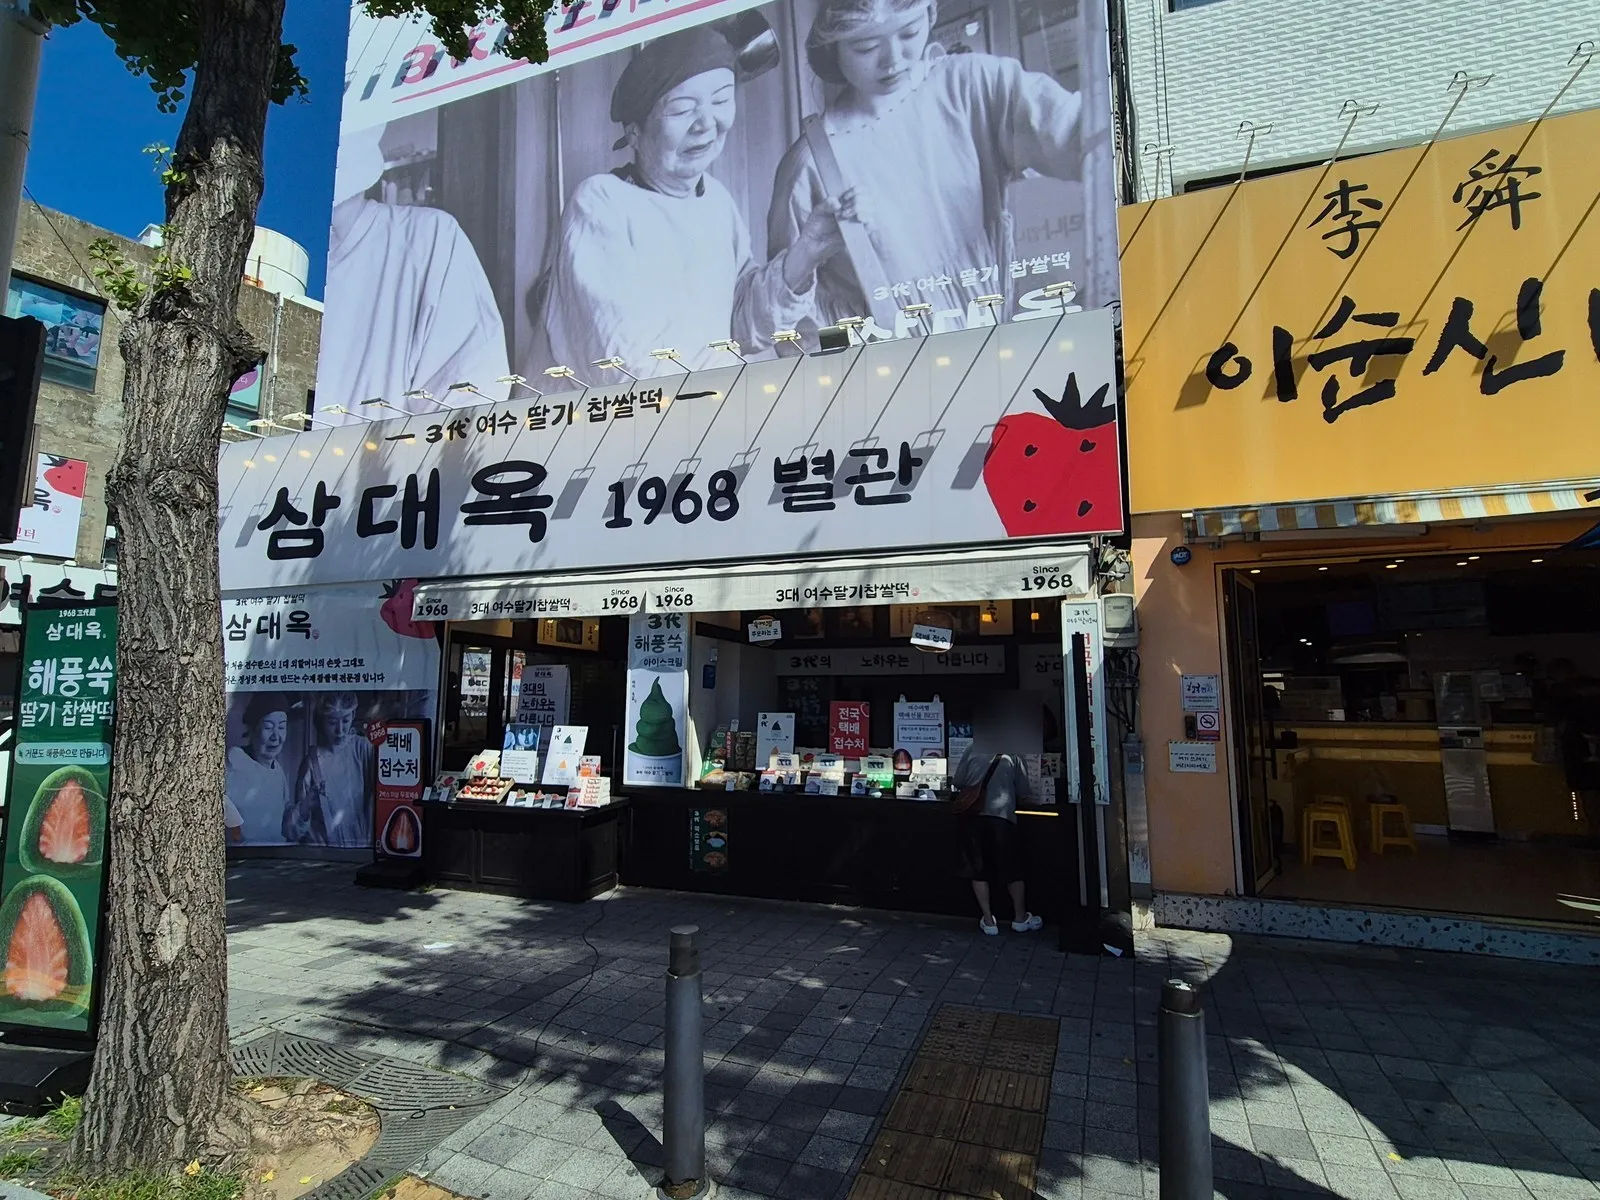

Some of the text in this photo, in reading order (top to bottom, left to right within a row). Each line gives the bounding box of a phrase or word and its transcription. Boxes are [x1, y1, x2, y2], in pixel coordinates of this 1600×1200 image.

[917, 273, 952, 292] 여수
[960, 264, 999, 287] 딸기
[1010, 251, 1071, 279] 찹쌀떡
[1206, 277, 1600, 424] 이순신
[476, 411, 517, 436] 여수
[528, 400, 573, 431] 딸기
[586, 387, 662, 422] 찹쌀떡
[257, 441, 923, 560] 삼대옥 1968 별관
[1033, 566, 1060, 574] Since
[1021, 574, 1073, 591] 1968
[655, 593, 694, 608] 1968
[776, 583, 910, 602] 3대 여수딸기찹쌀떡
[417, 604, 449, 616] 1968
[471, 598, 571, 615] 3대 여수딸기찹쌀떡
[602, 597, 638, 610] 1968
[59, 610, 76, 618] 1968
[46, 621, 101, 641] 삼대옥
[225, 610, 312, 641] 삼대옥
[635, 633, 683, 653] 해풍쑥
[644, 658, 683, 667] 아이스크림
[861, 653, 910, 668] 노하우는
[937, 652, 989, 667] 다릅니다
[28, 656, 113, 697] 해풍쑥
[362, 672, 385, 683] 입니다
[522, 683, 545, 694] 3대의
[521, 699, 556, 710] 노하우는
[20, 701, 114, 728] 딸기 찹쌀떡
[519, 713, 555, 725] 다릅니다
[838, 706, 861, 721] 전국
[838, 721, 860, 736] 택배
[386, 732, 412, 752] 택배
[833, 736, 865, 751] 접수처
[379, 757, 418, 779] 접수처
